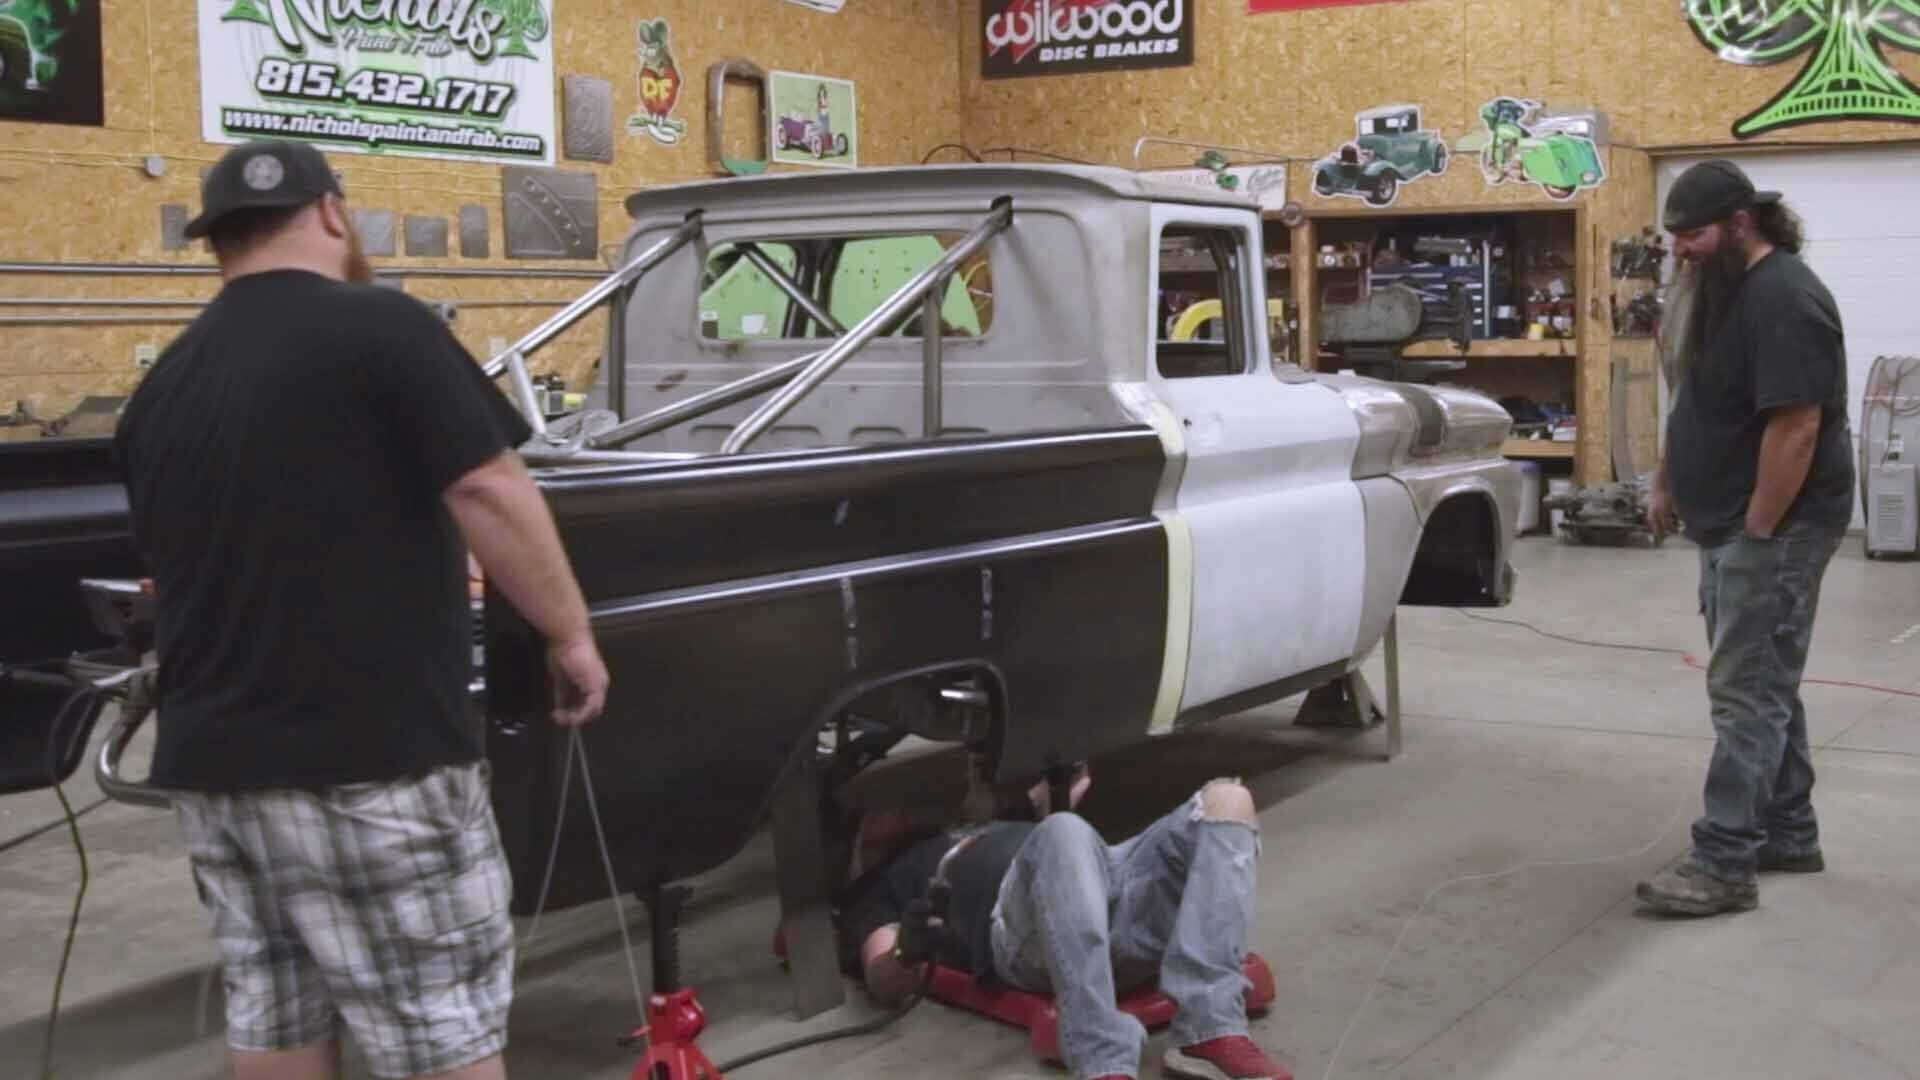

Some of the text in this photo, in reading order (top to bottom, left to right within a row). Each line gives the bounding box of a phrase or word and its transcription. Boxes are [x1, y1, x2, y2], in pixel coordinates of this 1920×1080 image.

[1039, 38, 1180, 62] DISC BRAKES
[256, 58, 514, 114] 815.432.1717
[224, 108, 540, 151] www.nicholspaintandfab.com
